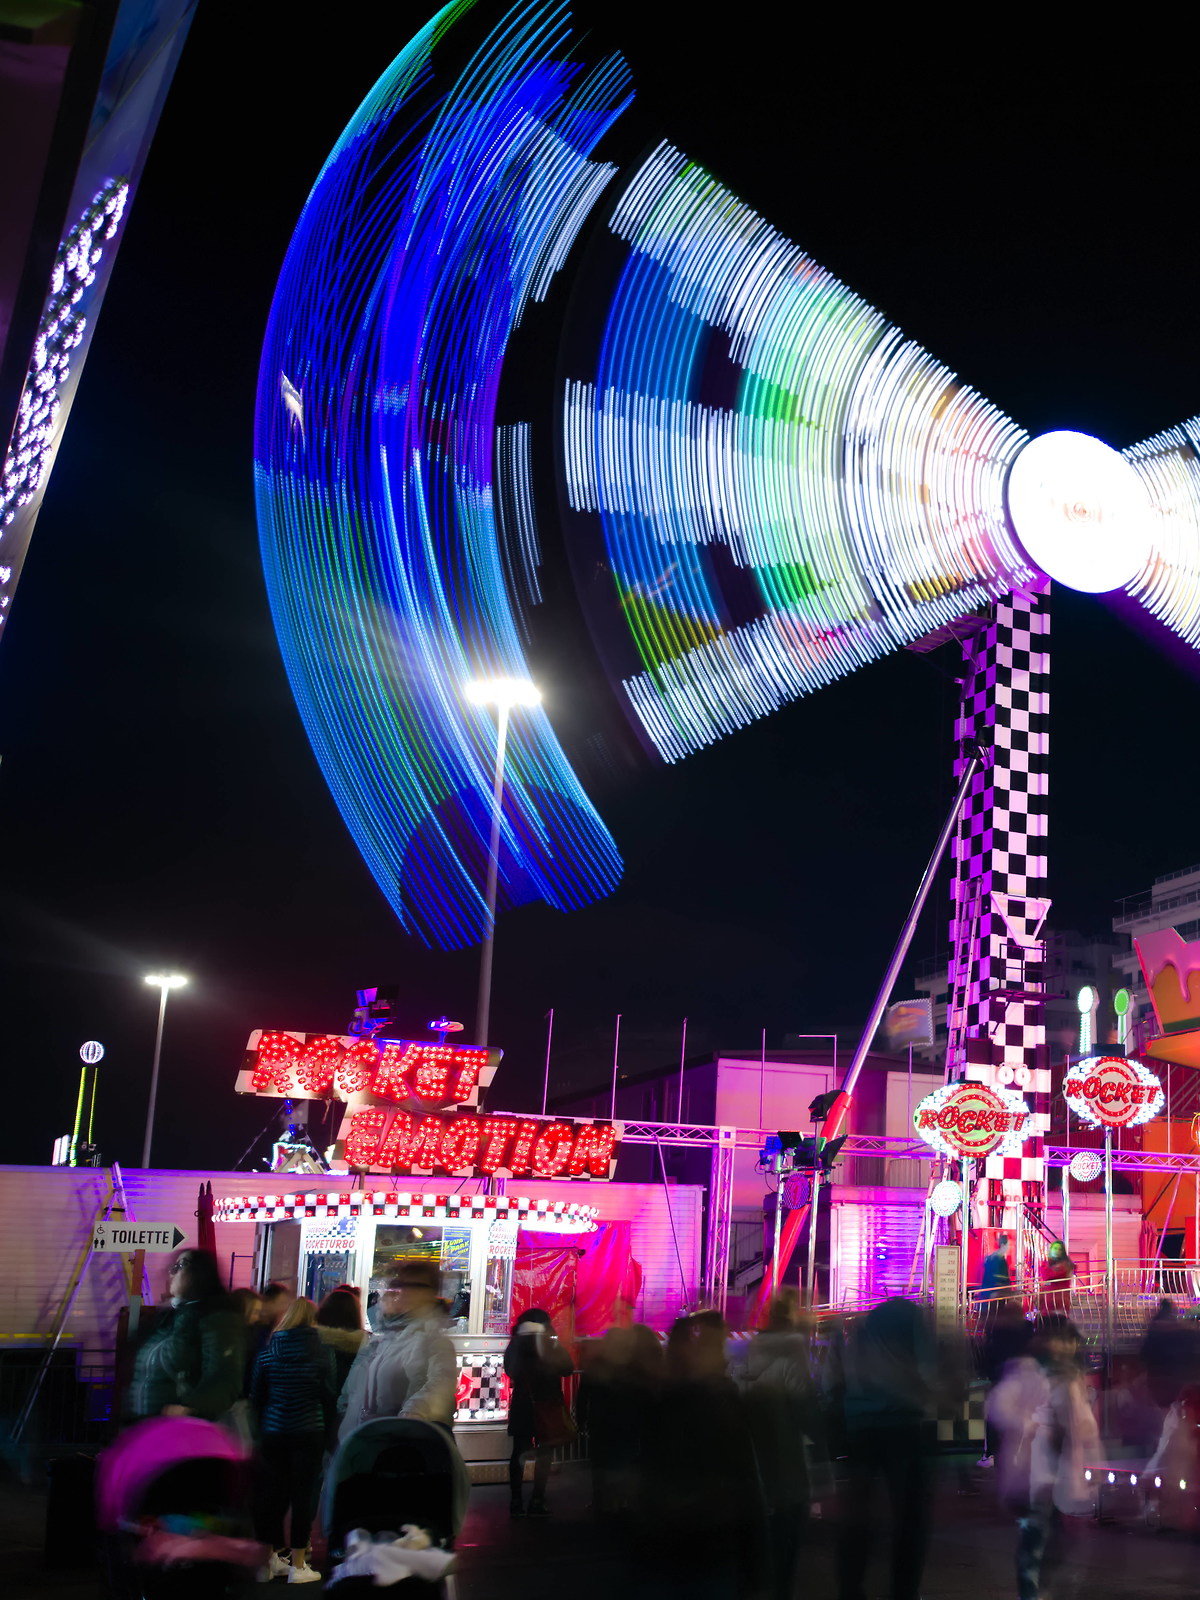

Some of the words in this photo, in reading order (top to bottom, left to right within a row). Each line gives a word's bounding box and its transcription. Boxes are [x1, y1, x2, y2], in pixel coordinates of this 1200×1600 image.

[252, 1031, 490, 1101] ROCKET
[1065, 1075, 1161, 1105] ROCKET
[918, 1105, 1029, 1133] ROCKET
[344, 1109, 617, 1175] EMOTION
[1073, 1161, 1099, 1170] ROCKET
[111, 1230, 170, 1244] TOILETTE
